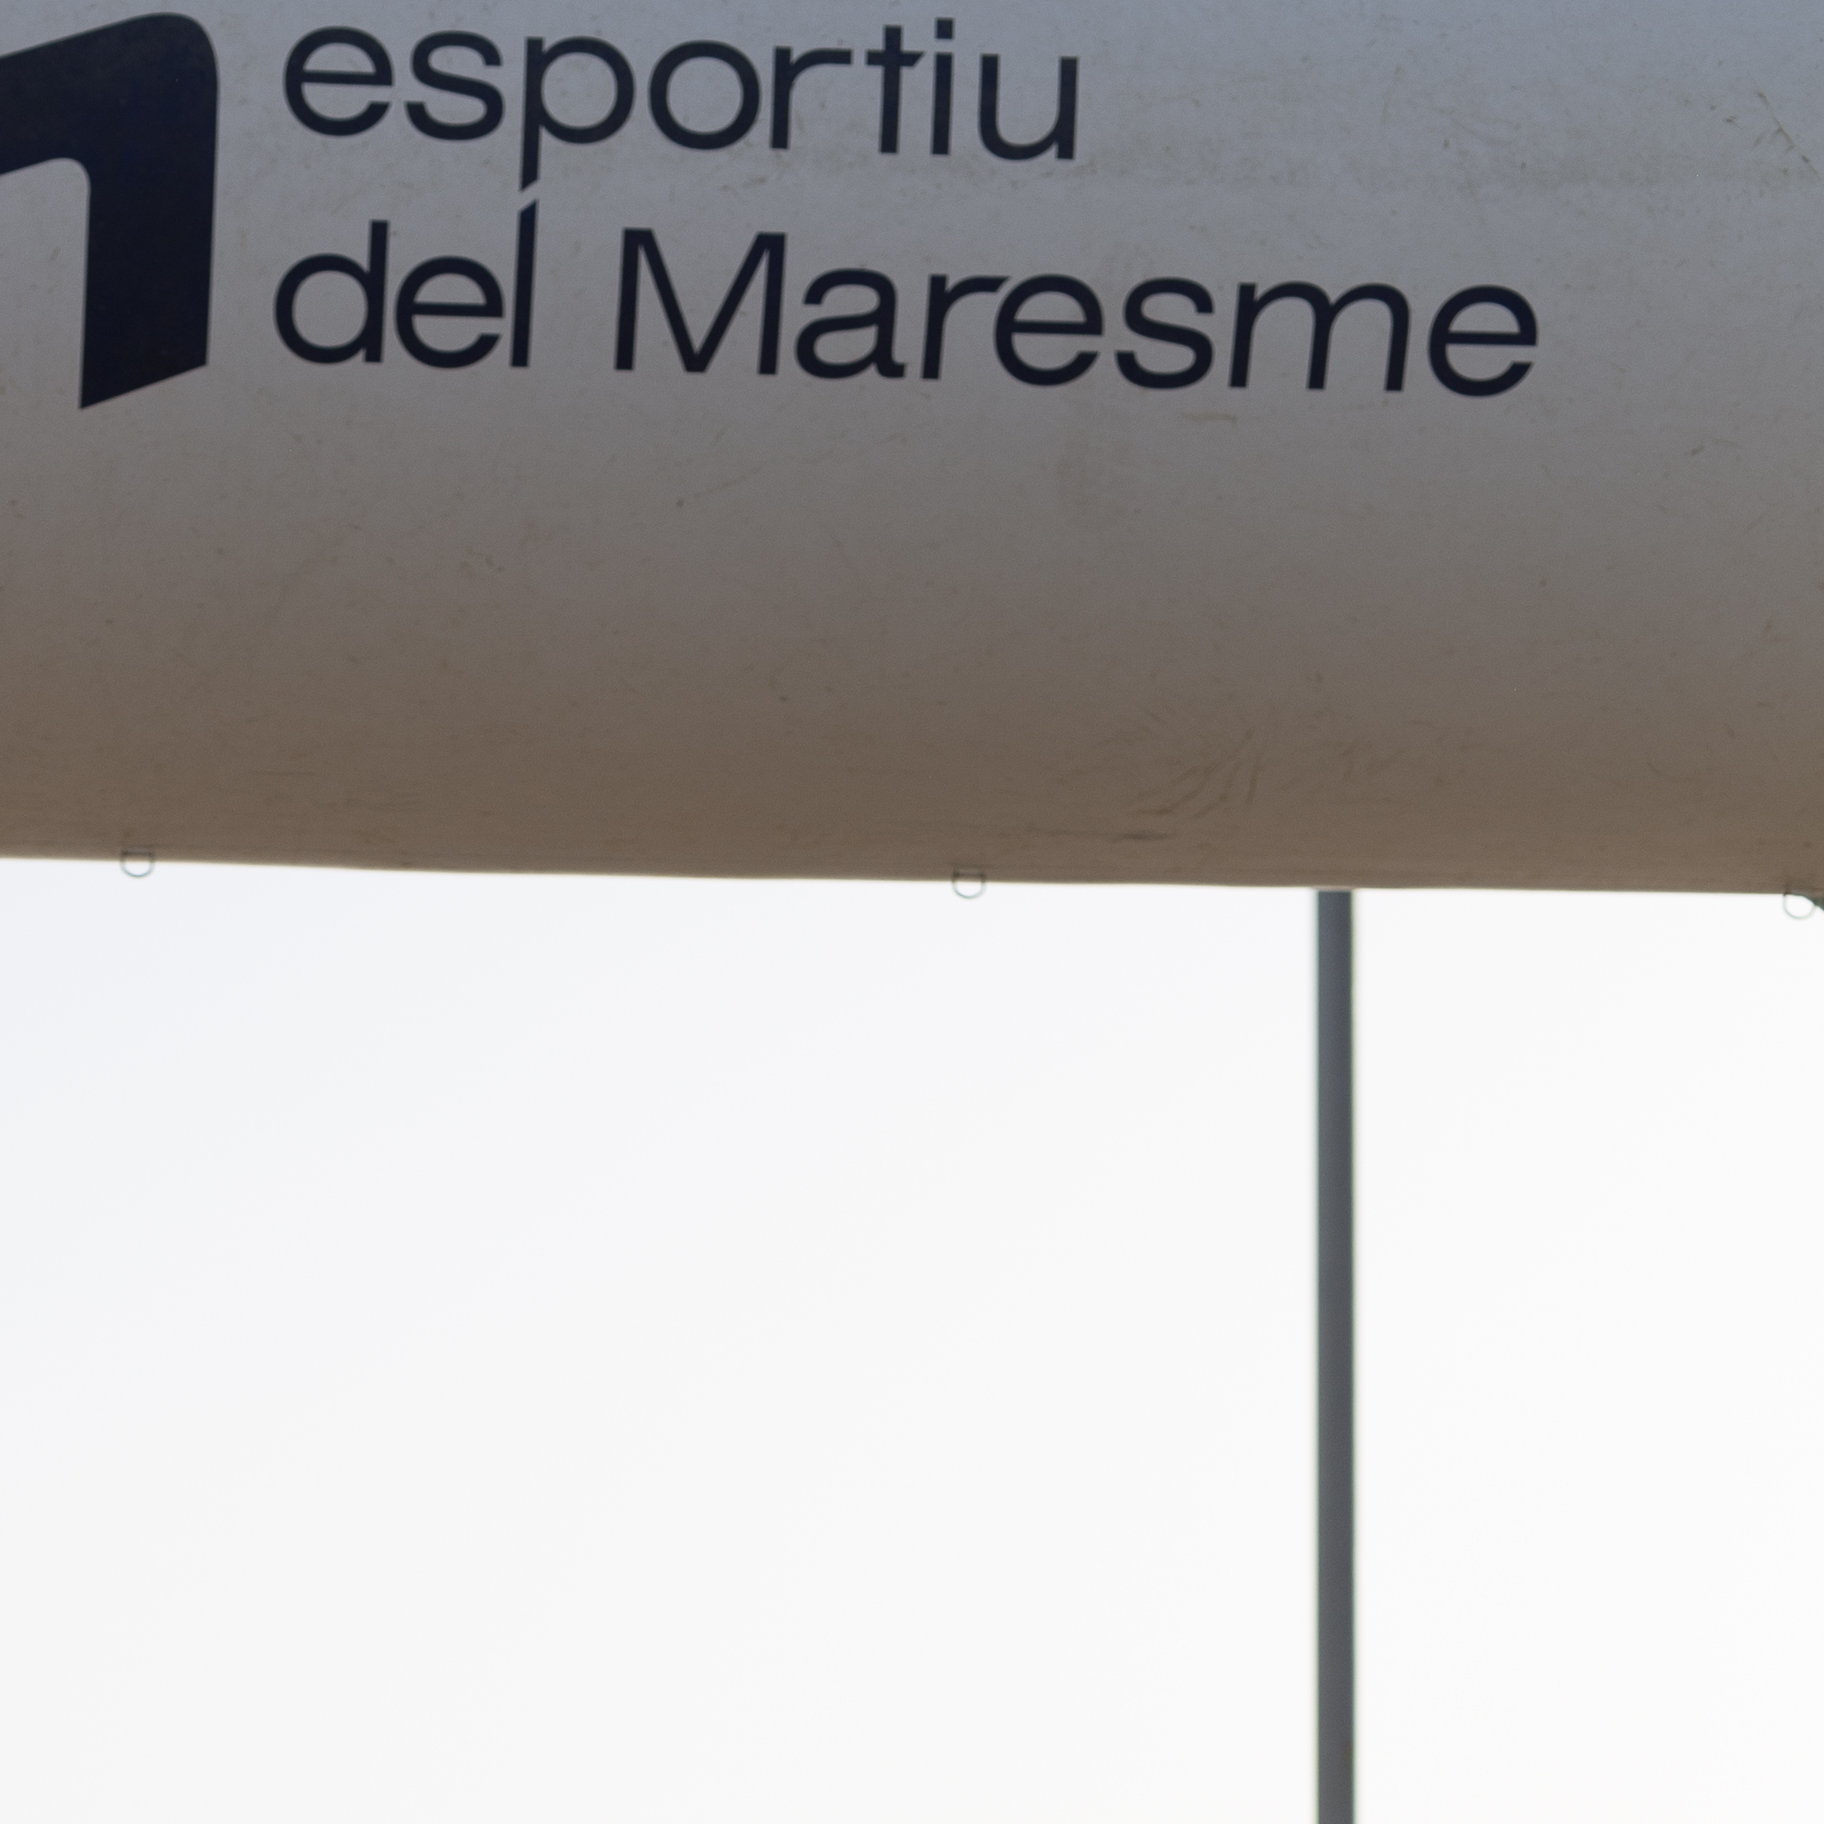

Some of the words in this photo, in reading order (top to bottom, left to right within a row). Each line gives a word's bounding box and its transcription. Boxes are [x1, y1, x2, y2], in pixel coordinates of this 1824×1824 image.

[282, 17, 1080, 193] esportiu
[272, 200, 539, 369] del
[613, 227, 1540, 398] Maresme
